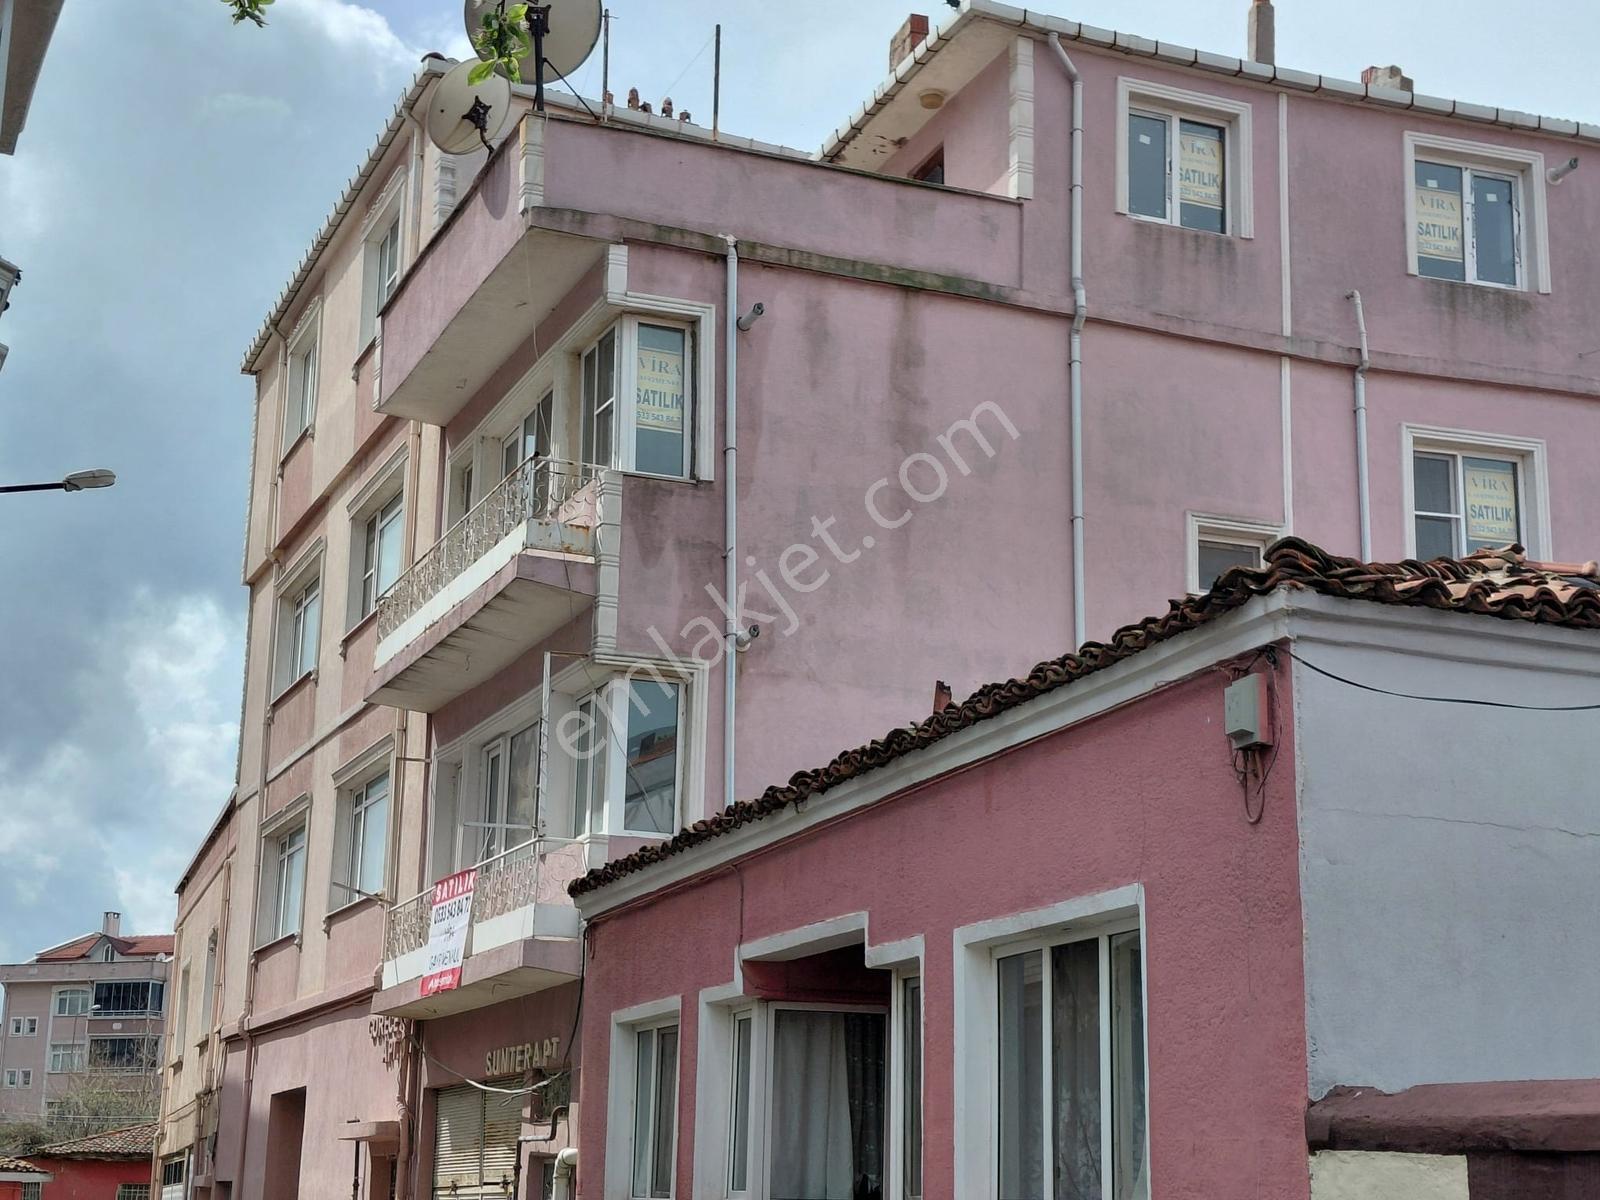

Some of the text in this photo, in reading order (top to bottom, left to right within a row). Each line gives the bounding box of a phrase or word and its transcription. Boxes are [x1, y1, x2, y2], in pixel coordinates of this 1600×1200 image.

[1179, 167, 1220, 189] SATILIK
[1417, 222, 1459, 241] SATILIK
[636, 387, 683, 410] SATILIK
[1470, 504, 1513, 522] SATILIK
[436, 871, 476, 902] SATILIK
